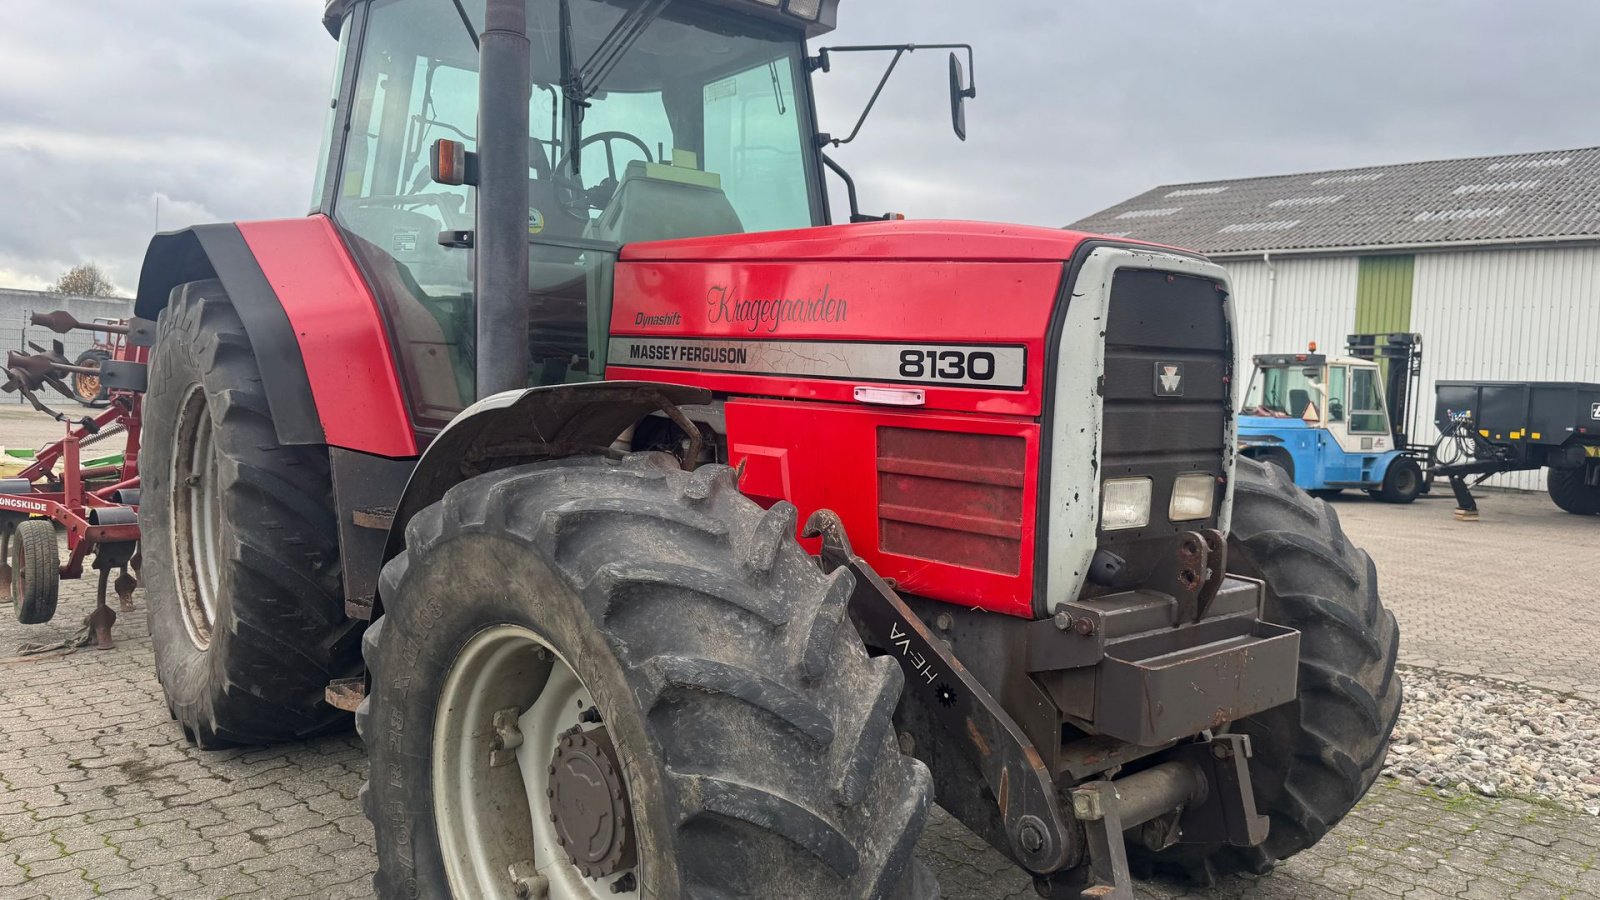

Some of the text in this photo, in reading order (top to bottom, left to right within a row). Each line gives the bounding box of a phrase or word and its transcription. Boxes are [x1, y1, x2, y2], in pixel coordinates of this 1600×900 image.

[707, 284, 848, 332] Kragegaarden
[635, 312, 682, 327] Dynashift
[630, 344, 747, 364] MASSEY FERGUSON
[899, 350, 995, 381] 8130
[0, 498, 47, 511] ONGSKILDE
